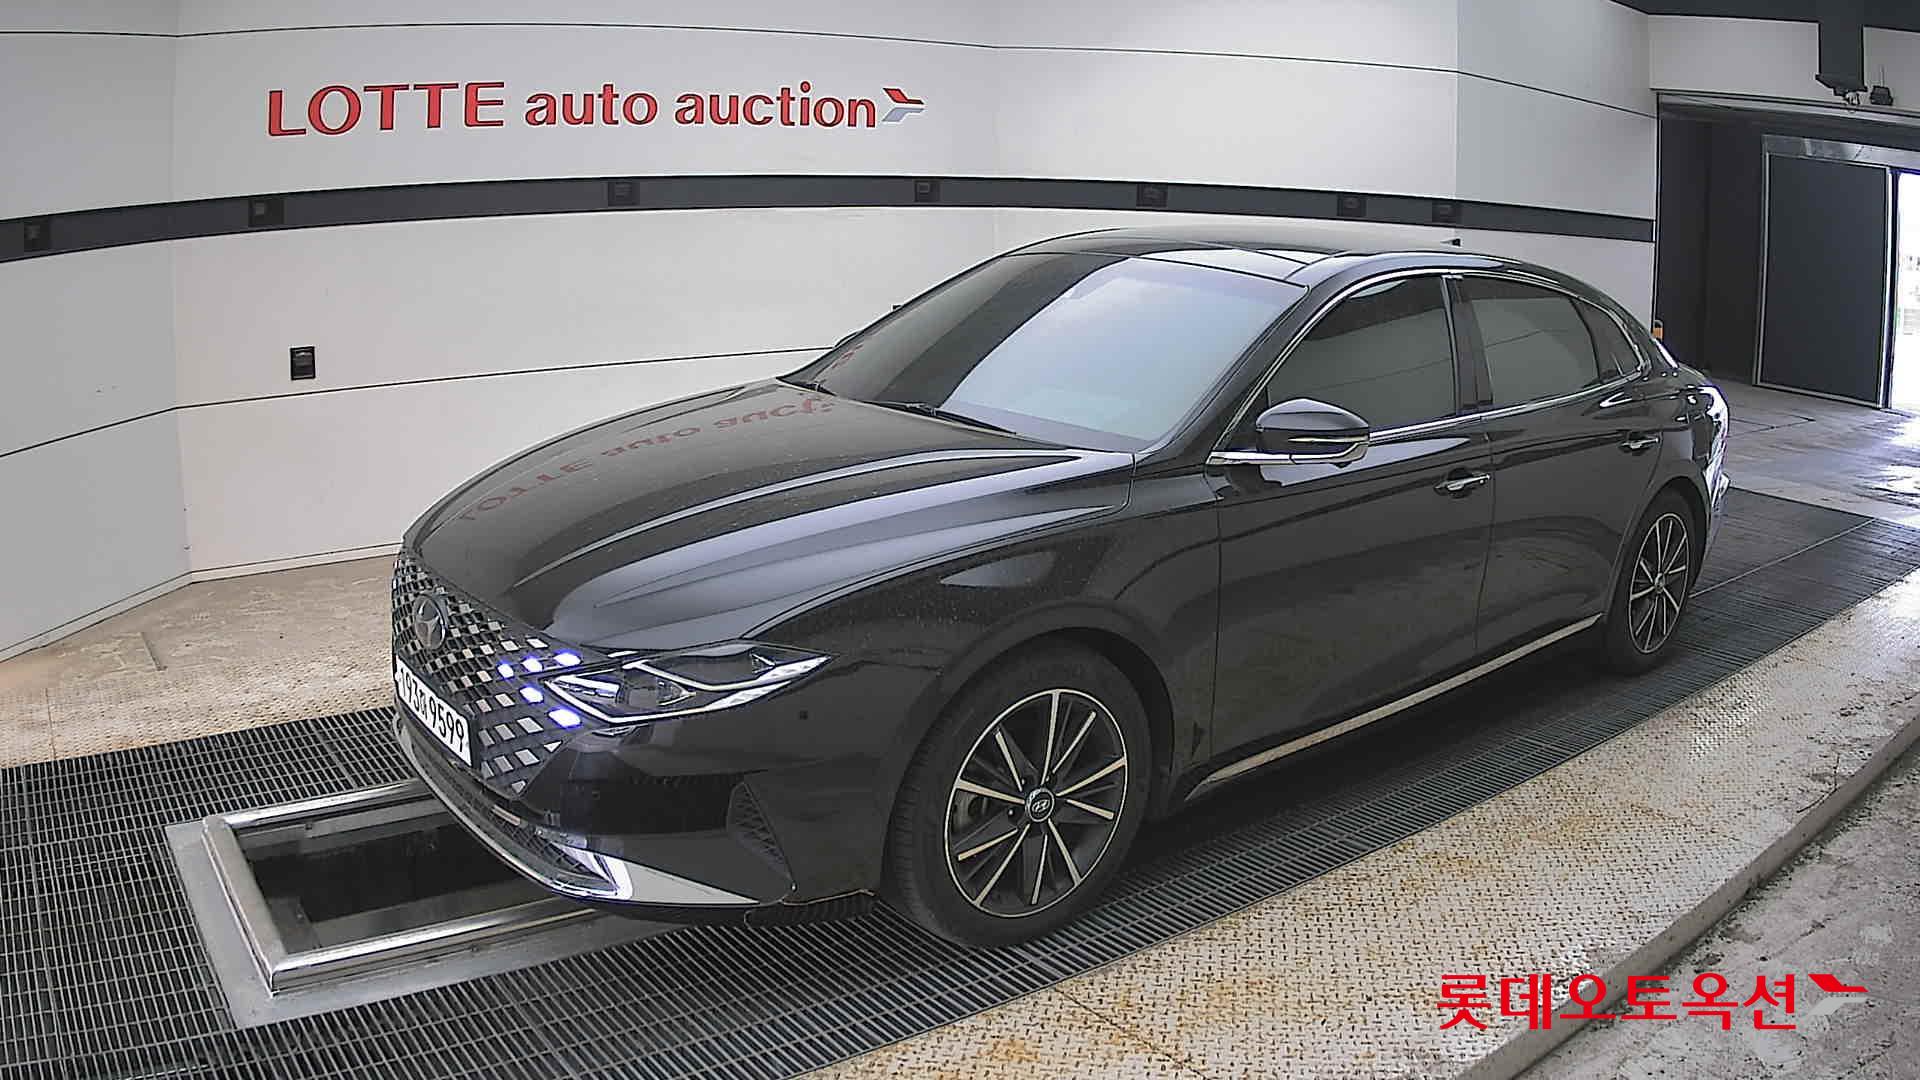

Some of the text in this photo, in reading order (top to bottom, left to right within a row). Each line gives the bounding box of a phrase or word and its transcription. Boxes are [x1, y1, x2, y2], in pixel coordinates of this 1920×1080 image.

[268, 81, 876, 136] LOTTE auto auction
